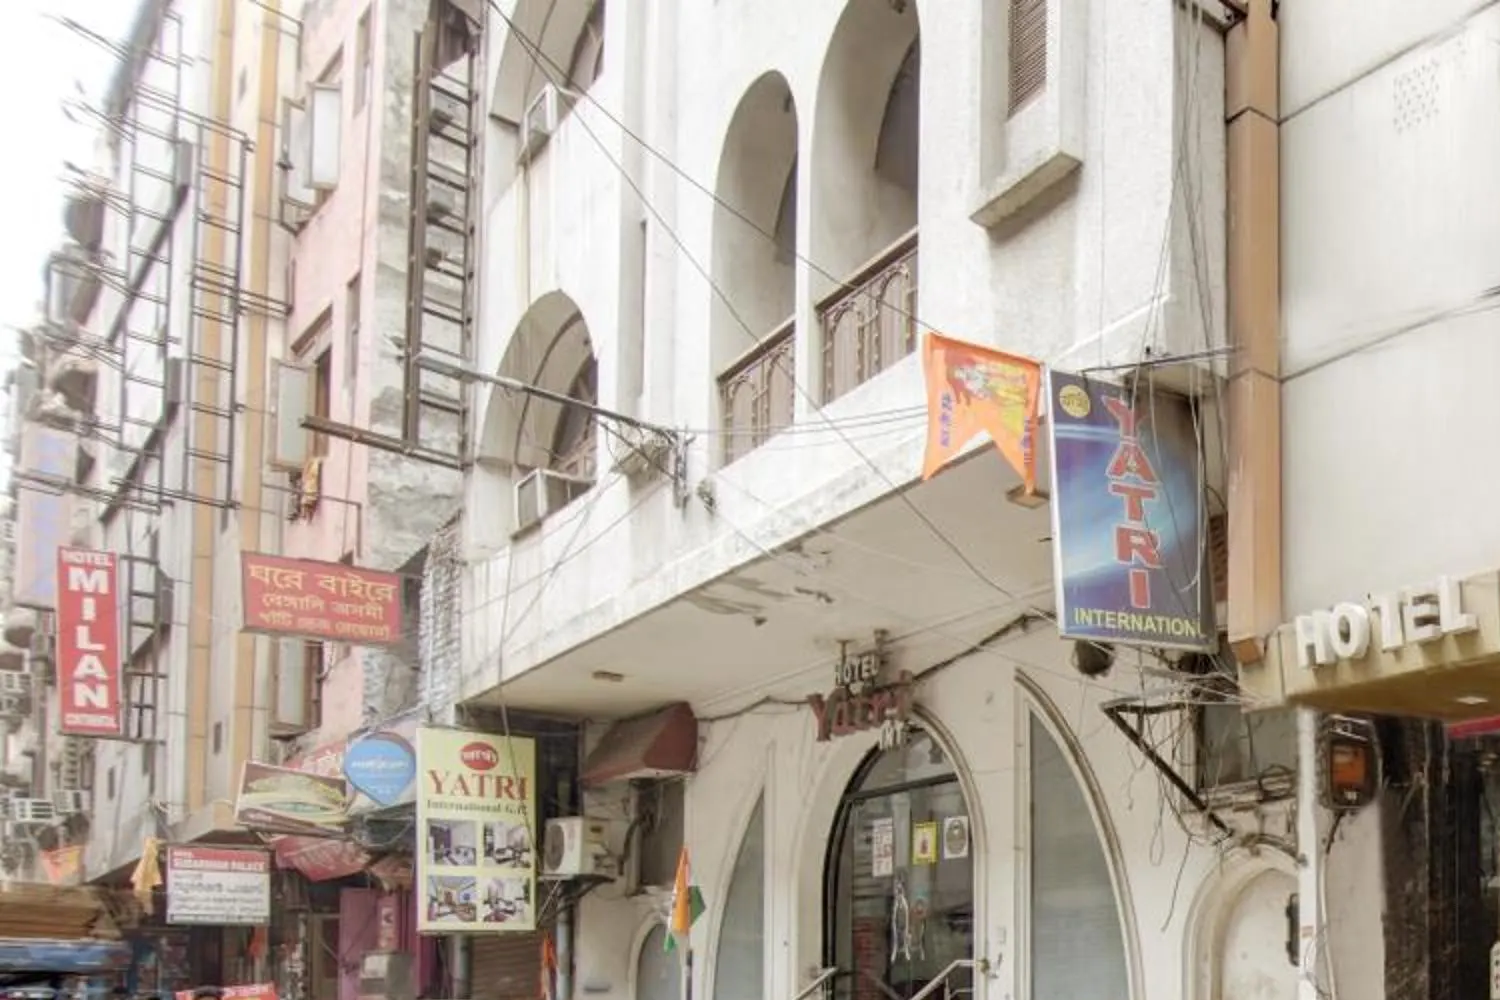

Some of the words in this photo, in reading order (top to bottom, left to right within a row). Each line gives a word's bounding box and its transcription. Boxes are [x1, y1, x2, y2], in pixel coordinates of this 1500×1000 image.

[1101, 394, 1163, 609] YATRI
[67, 566, 110, 709] MILAN
[1295, 575, 1479, 668] HOTEL
[426, 768, 529, 802] YATRI
